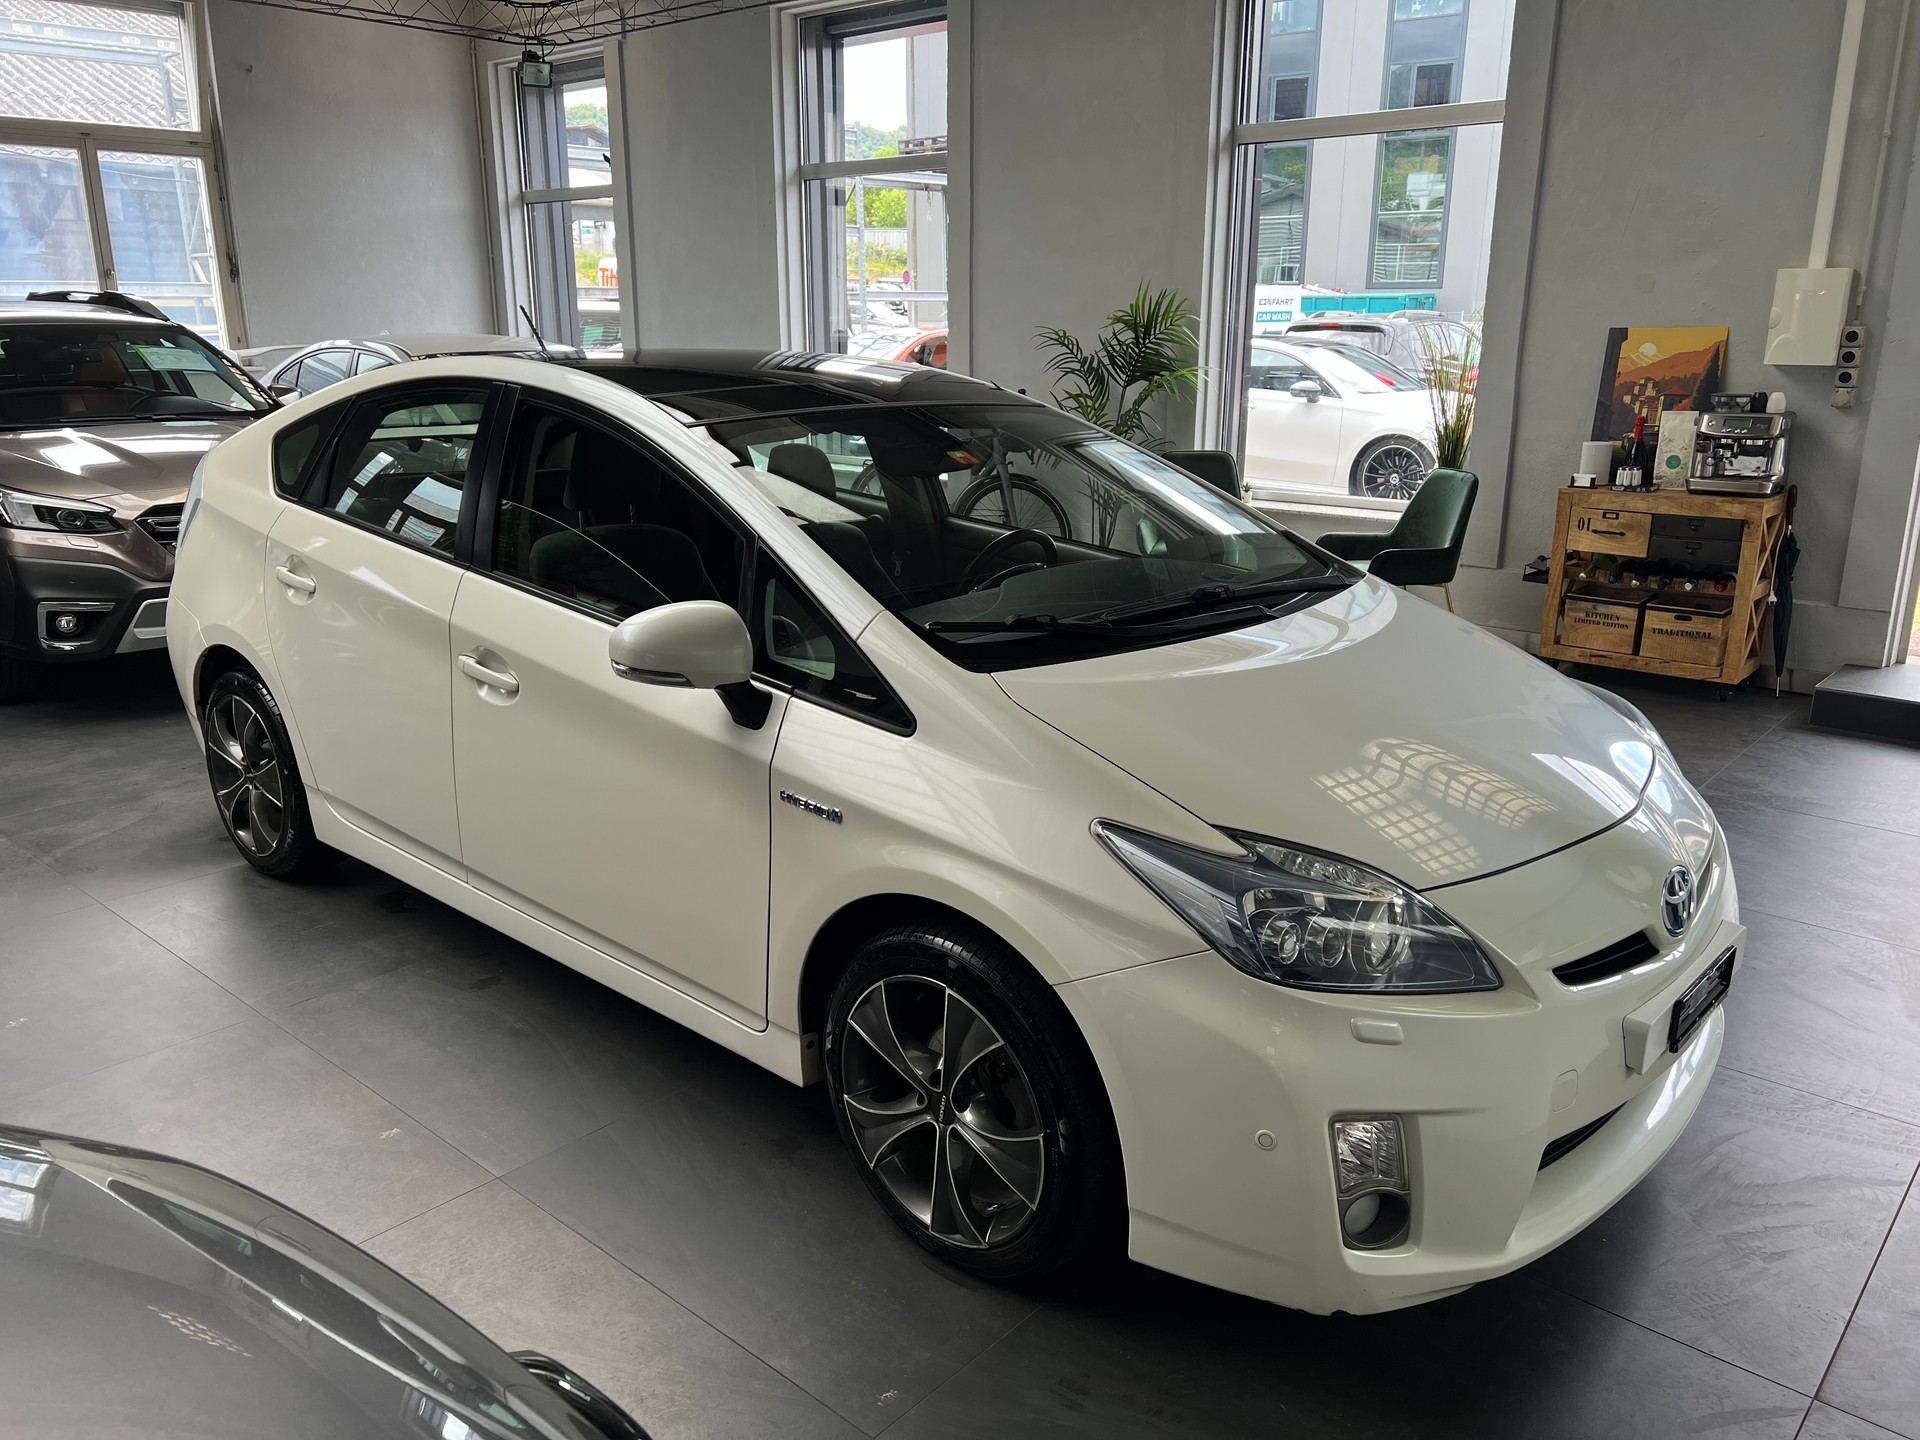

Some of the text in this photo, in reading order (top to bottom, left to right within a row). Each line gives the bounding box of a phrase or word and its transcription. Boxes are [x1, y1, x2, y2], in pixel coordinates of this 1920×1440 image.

[1258, 298, 1294, 306] EINFAHRT
[1257, 312, 1291, 321] CAR WASH
[1585, 610, 1620, 621] KITCHEN
[1574, 617, 1629, 629] LIMITED EDITION
[1652, 627, 1713, 639] TRADITIONAL
